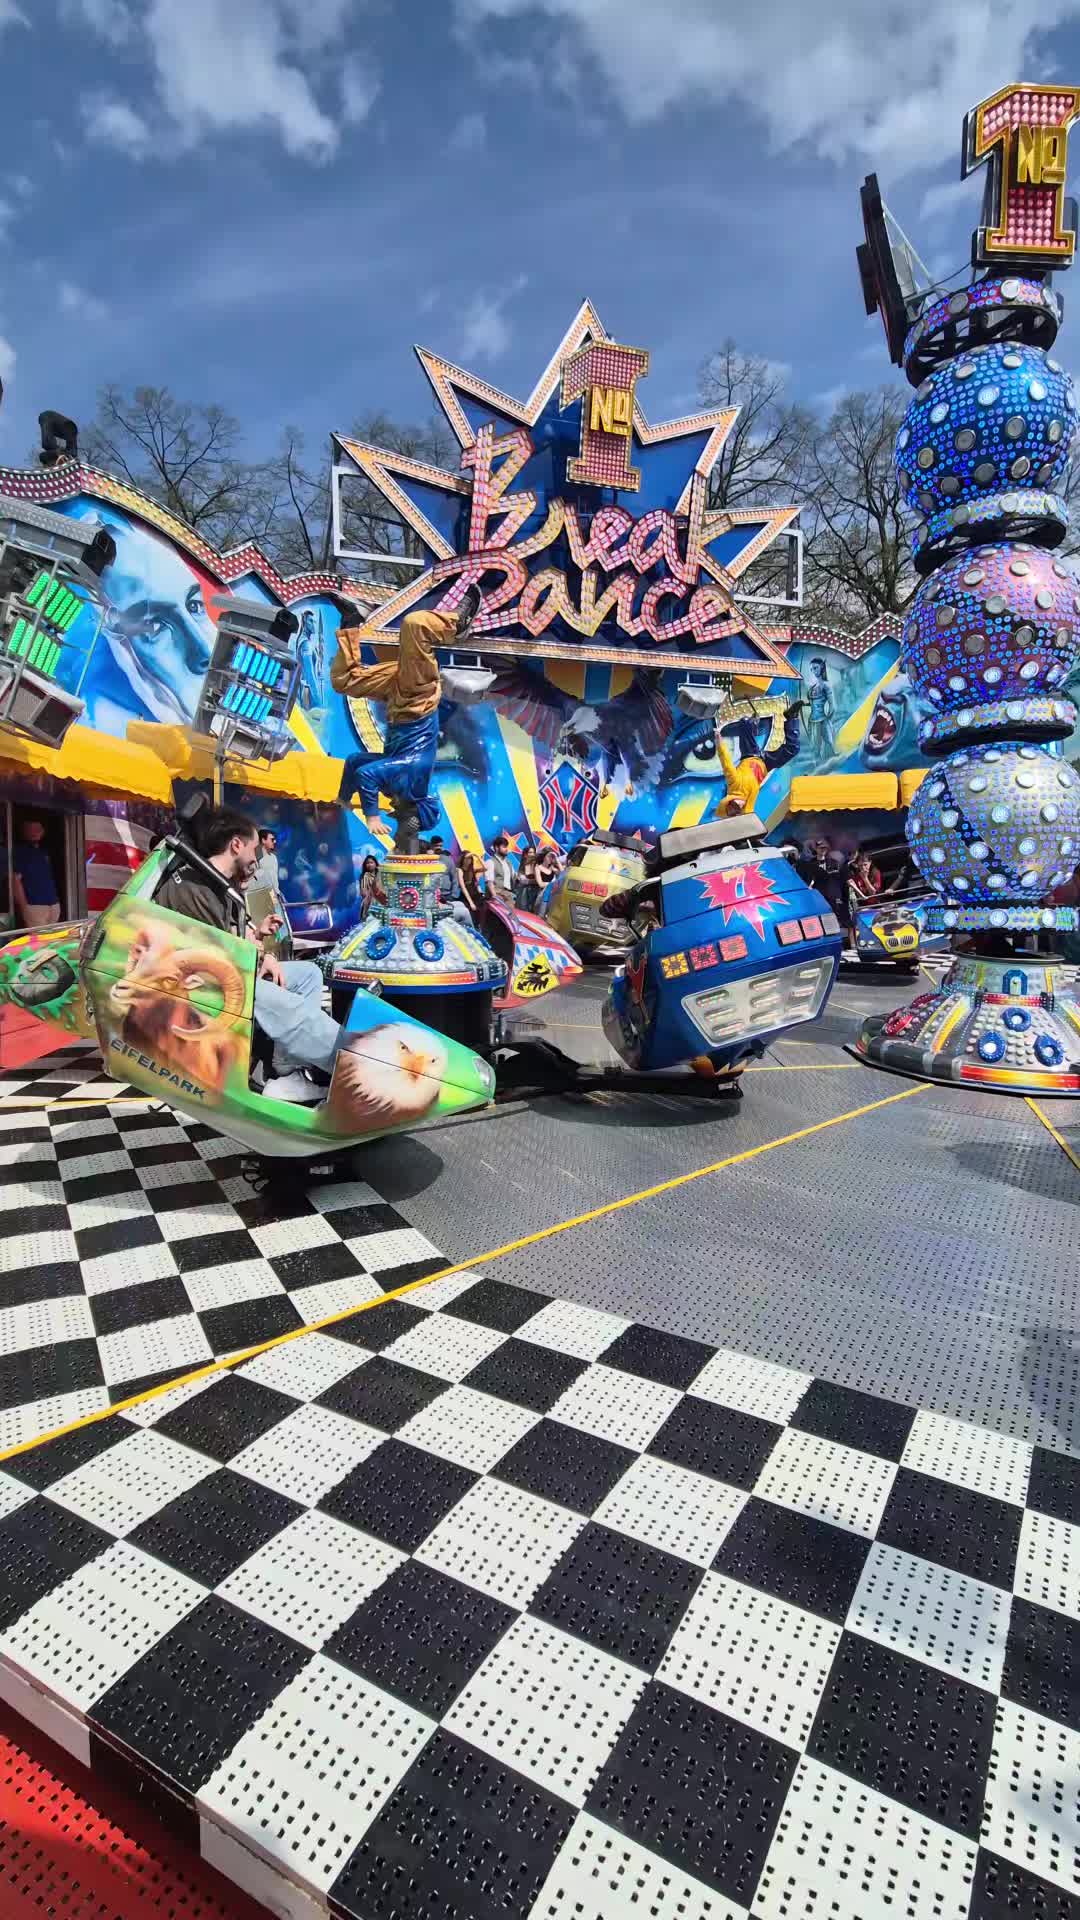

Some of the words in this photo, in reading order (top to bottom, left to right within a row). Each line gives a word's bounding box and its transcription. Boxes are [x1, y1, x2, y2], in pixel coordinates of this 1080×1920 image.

[968, 83, 1080, 256] 1
[560, 341, 650, 492] 1
[460, 421, 737, 588] Break
[433, 547, 749, 644] Dance
[110, 1039, 206, 1099] EIFELPARK
